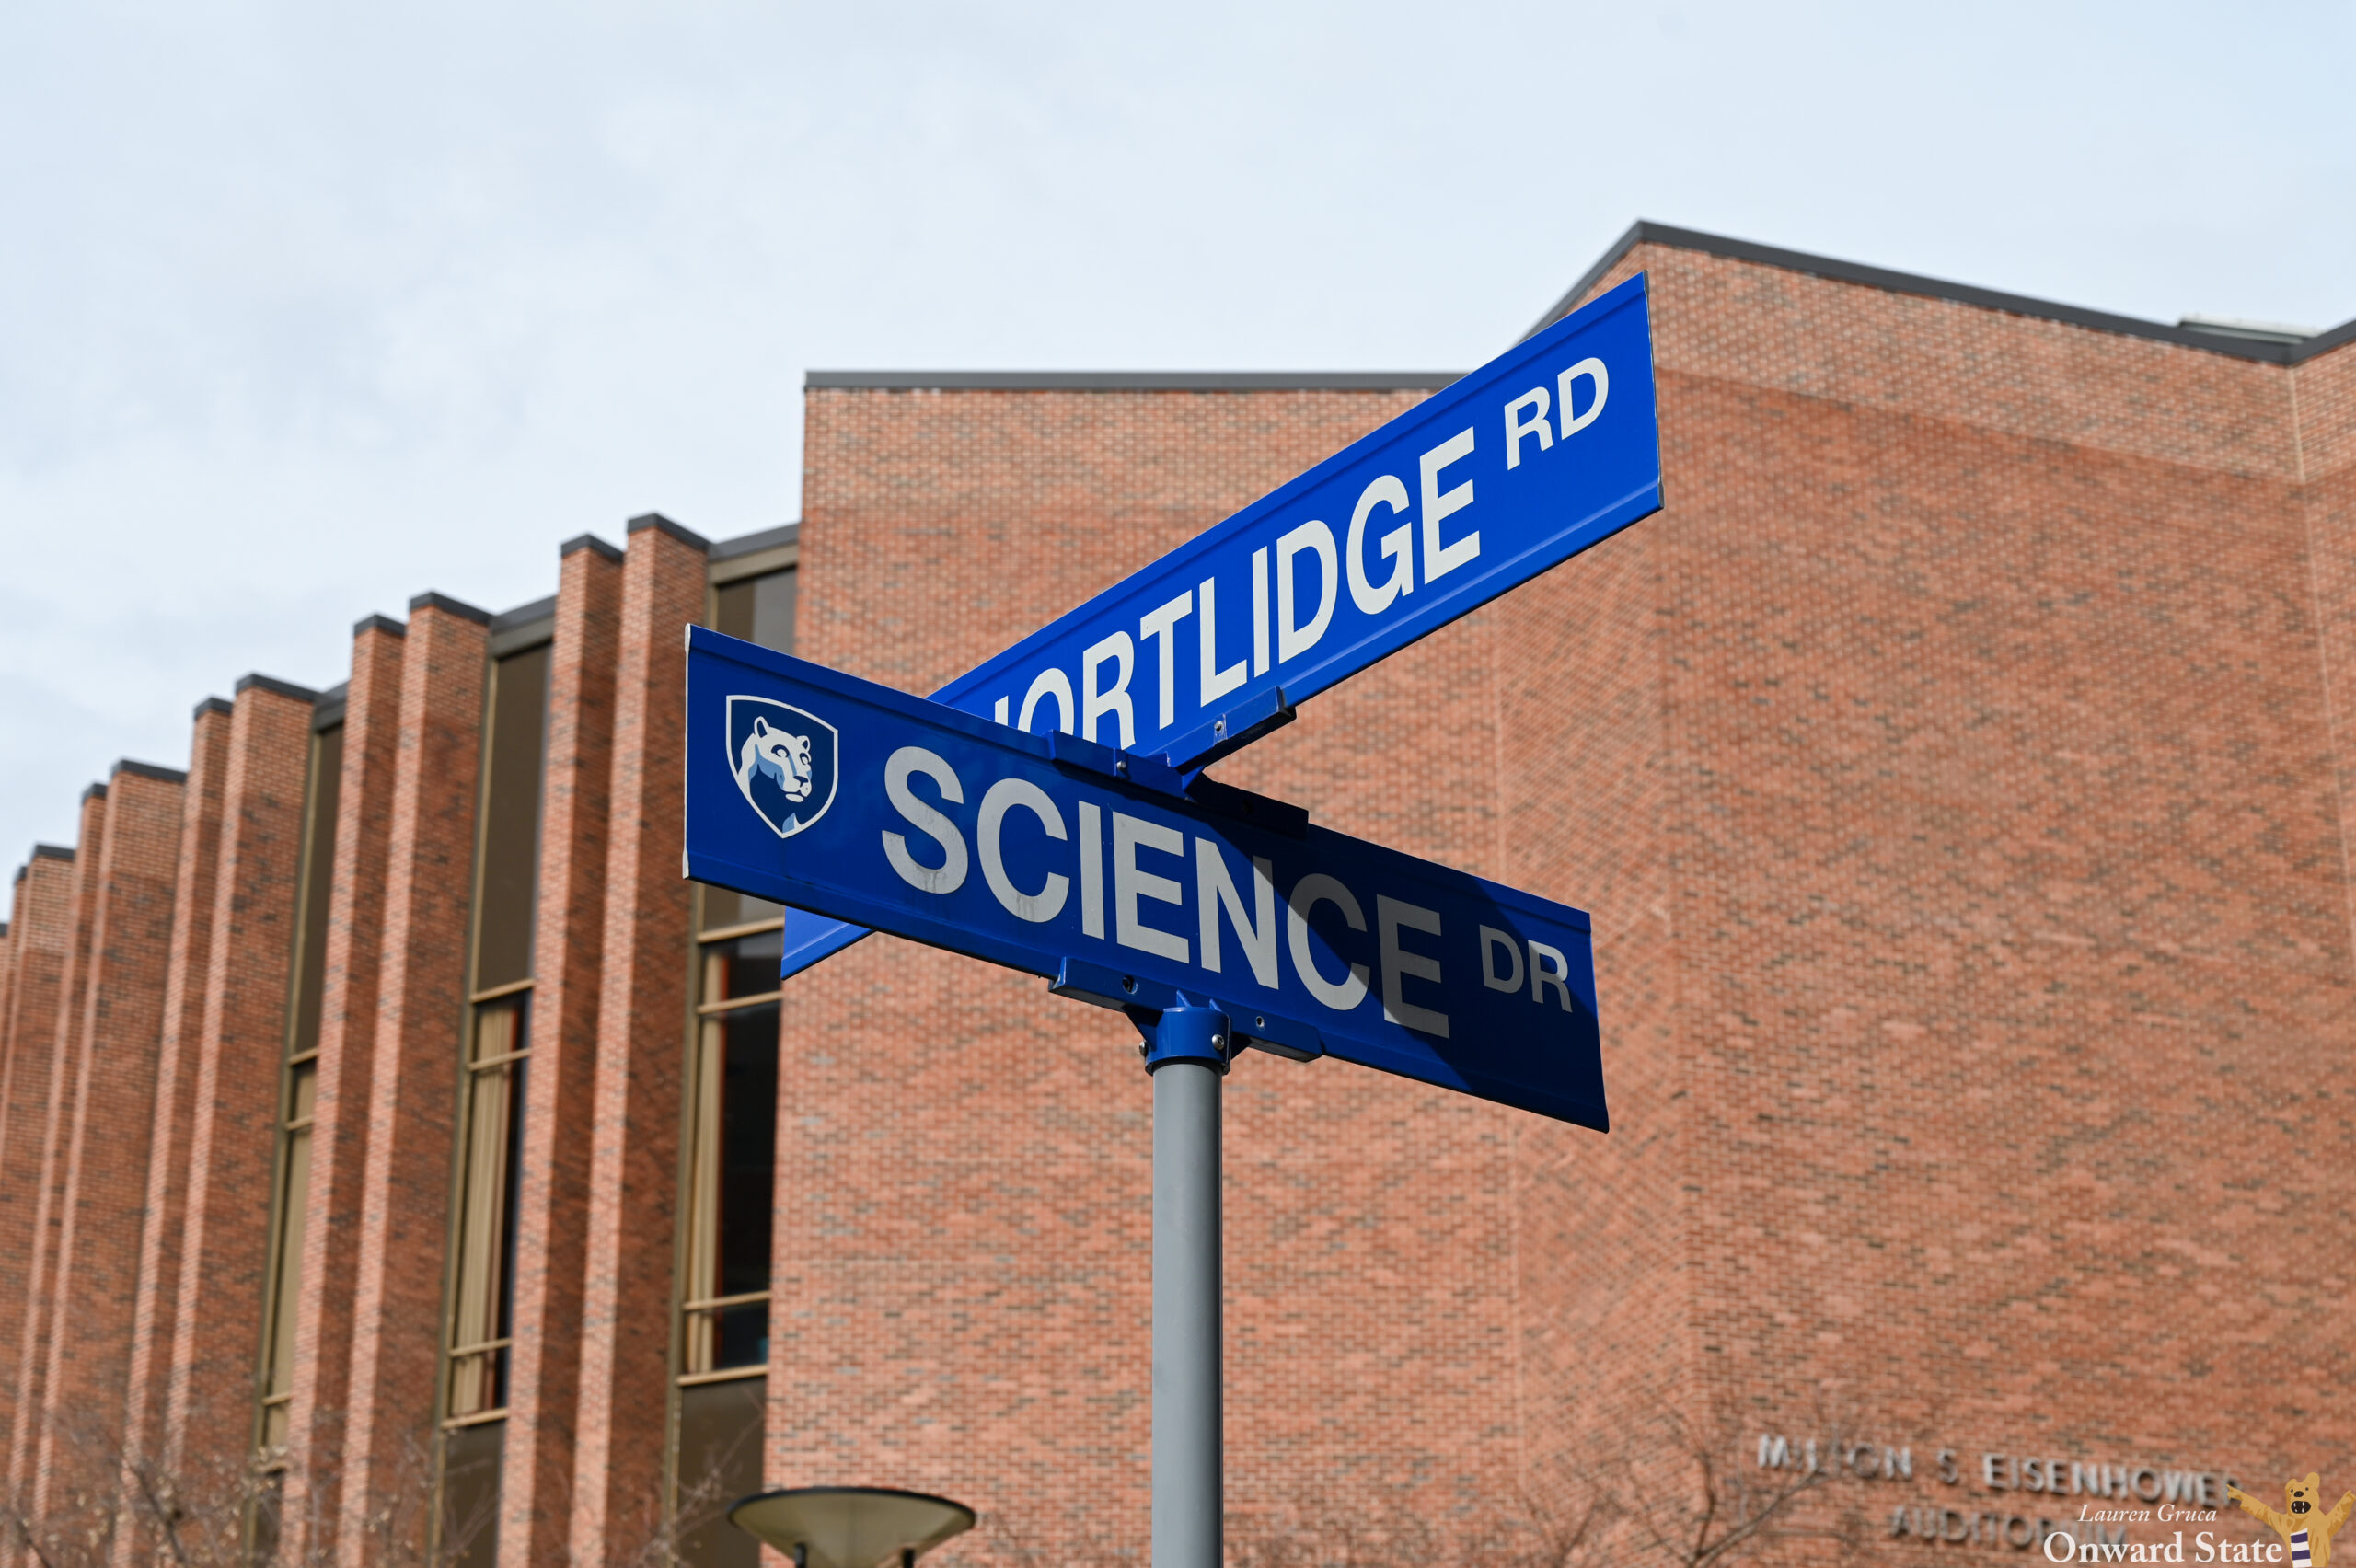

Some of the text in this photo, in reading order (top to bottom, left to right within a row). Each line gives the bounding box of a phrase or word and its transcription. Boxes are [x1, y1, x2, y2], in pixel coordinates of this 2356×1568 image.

[995, 357, 1610, 751] ORTLIDGE RD
[882, 746, 1573, 1038] SCIENCE DR
[1936, 1448, 1958, 1484] S
